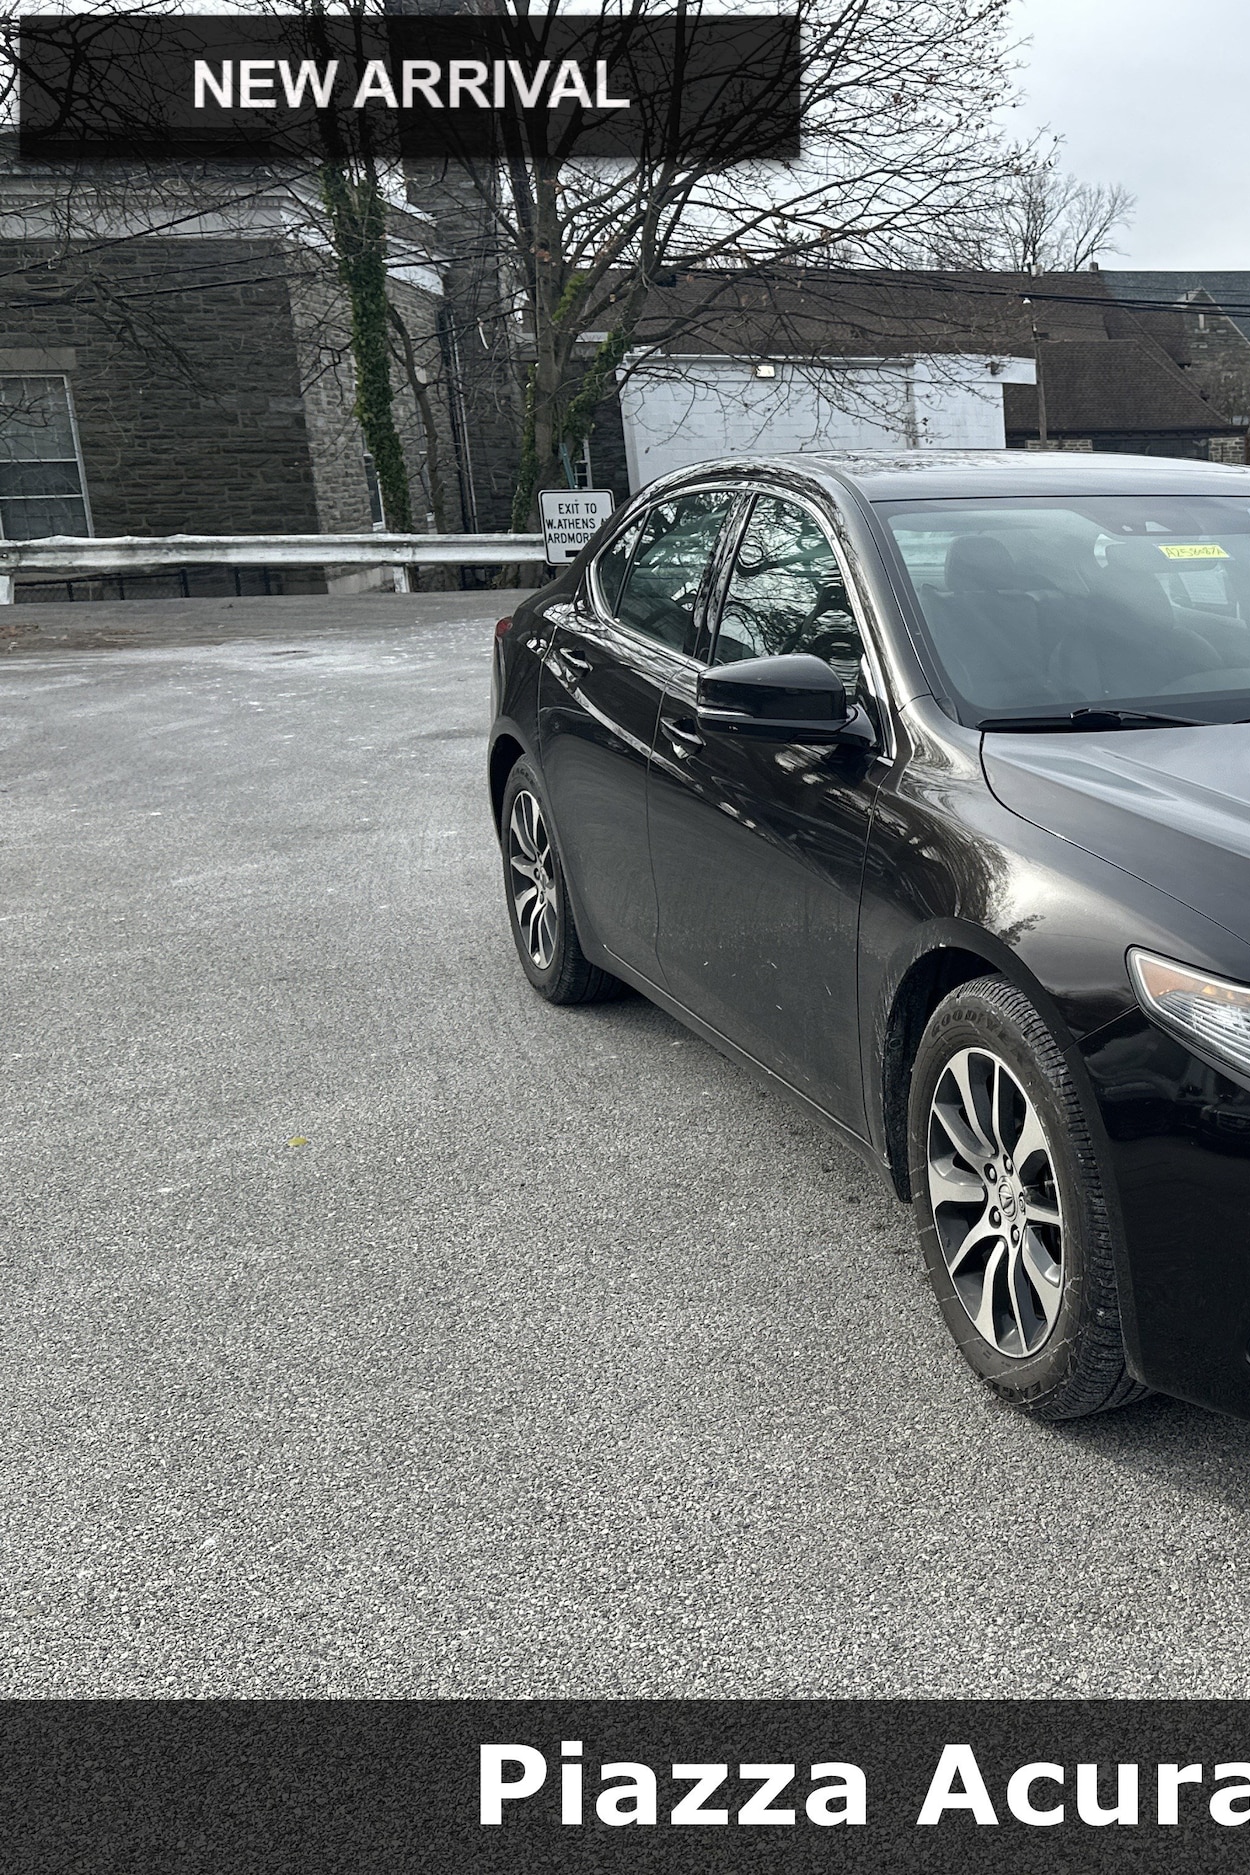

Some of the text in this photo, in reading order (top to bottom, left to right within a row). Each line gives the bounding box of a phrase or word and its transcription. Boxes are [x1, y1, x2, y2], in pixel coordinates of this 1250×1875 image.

[558, 503, 597, 514] EXIT TO
[546, 519, 596, 530] W.ATHENS
